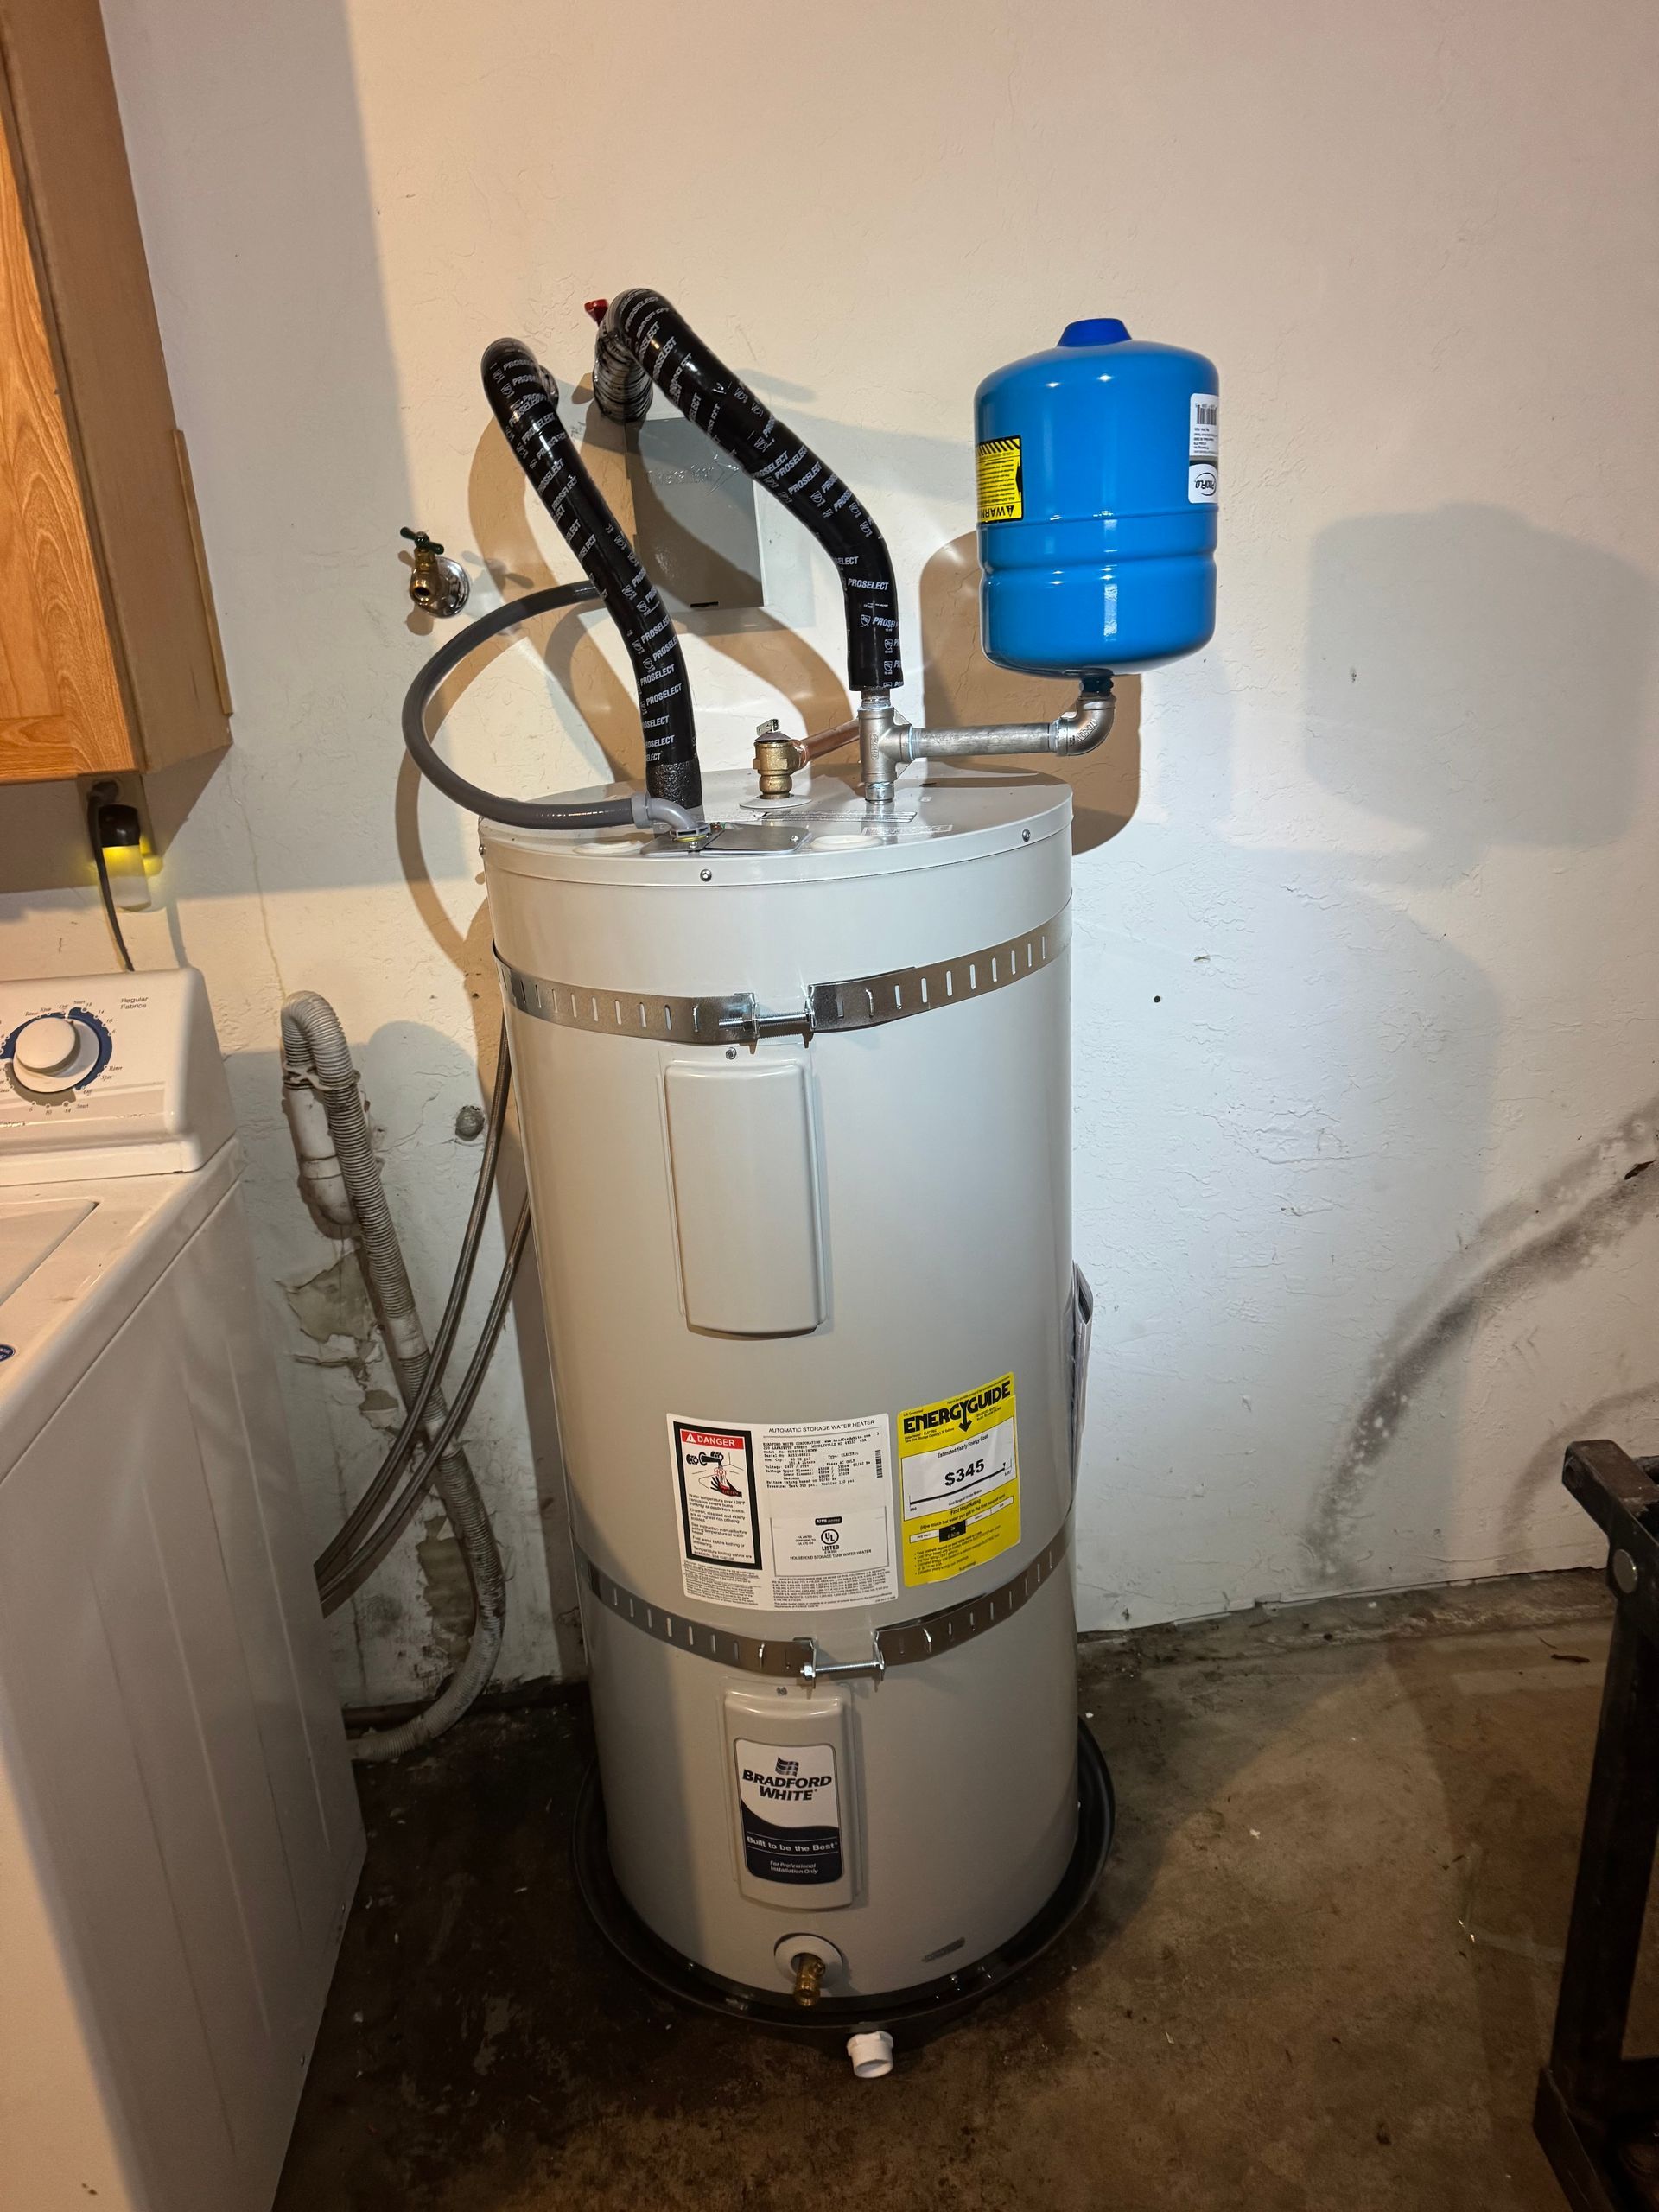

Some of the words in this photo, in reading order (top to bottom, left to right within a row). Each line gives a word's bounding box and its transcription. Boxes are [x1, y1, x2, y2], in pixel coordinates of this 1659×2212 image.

[848, 578, 889, 590] PROSELECT
[640, 664, 675, 686] PROSELECT
[645, 683, 683, 706] PROSELECT
[903, 1380, 1011, 1434] ENERGYGUIDE
[697, 1435, 735, 1446] DANGER
[937, 1446, 957, 1459] Estimated
[957, 1444, 968, 1452] Yearly
[968, 1438, 980, 1447] Energy
[944, 1458, 985, 1487] $345
[825, 1532, 835, 1541] UL
[742, 1769, 832, 1789] BRADFORD
[759, 1785, 814, 1801] WHITE
[747, 1836, 766, 1847] Built
[812, 1842, 835, 1851] Best
